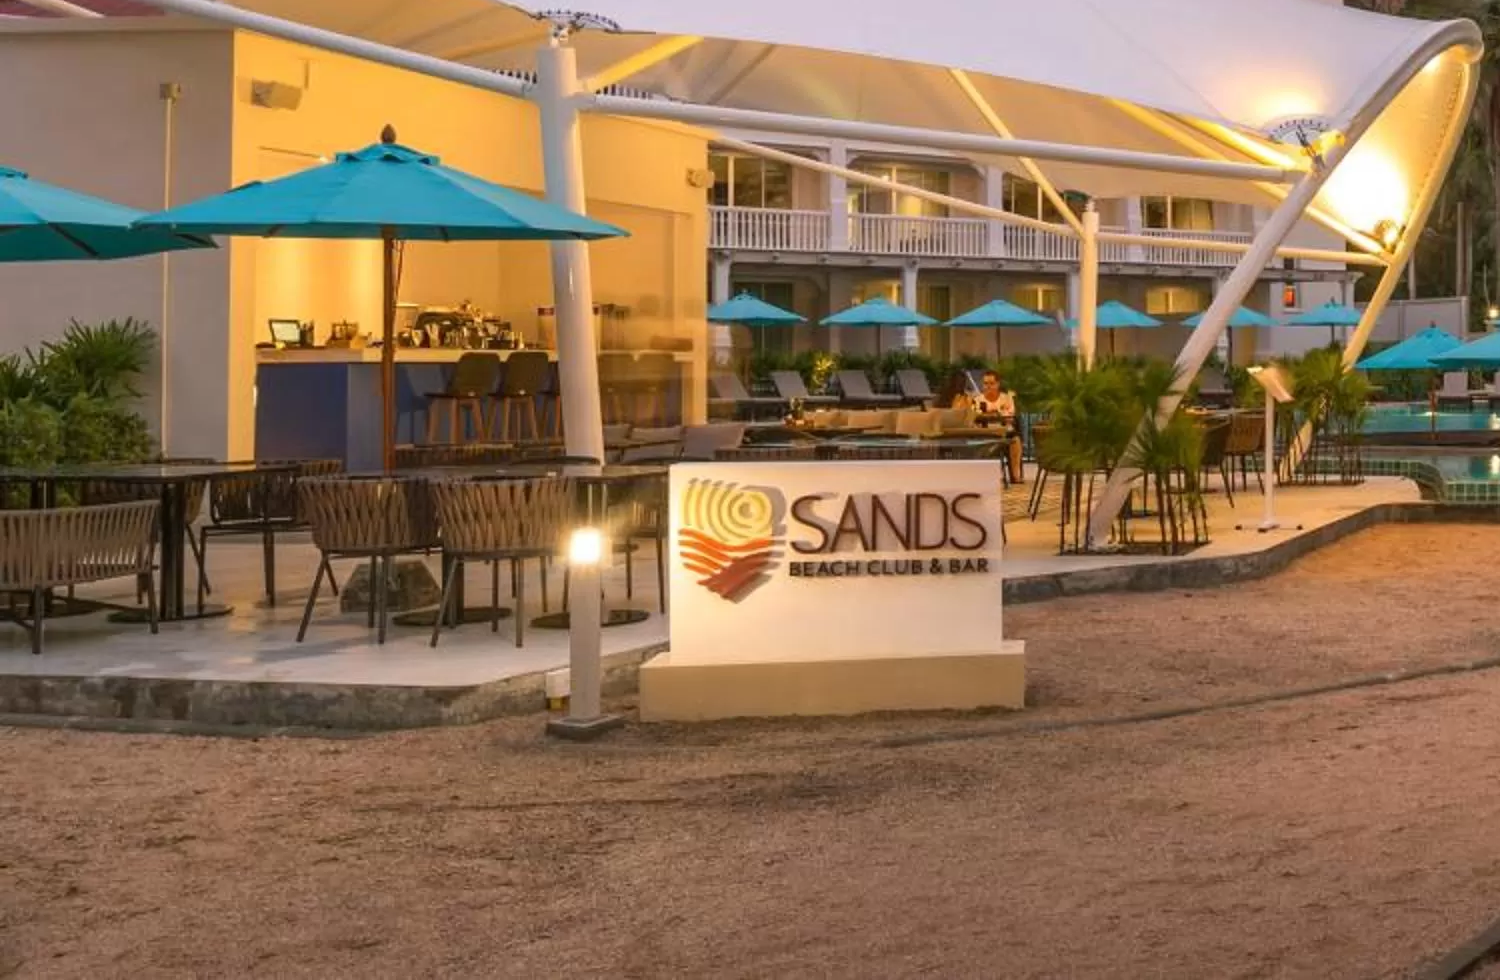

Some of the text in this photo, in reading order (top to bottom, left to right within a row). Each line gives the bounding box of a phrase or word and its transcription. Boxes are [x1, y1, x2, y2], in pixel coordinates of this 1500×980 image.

[790, 493, 987, 554] SANDS
[789, 558, 989, 577] BEACH CLUB & BAR
